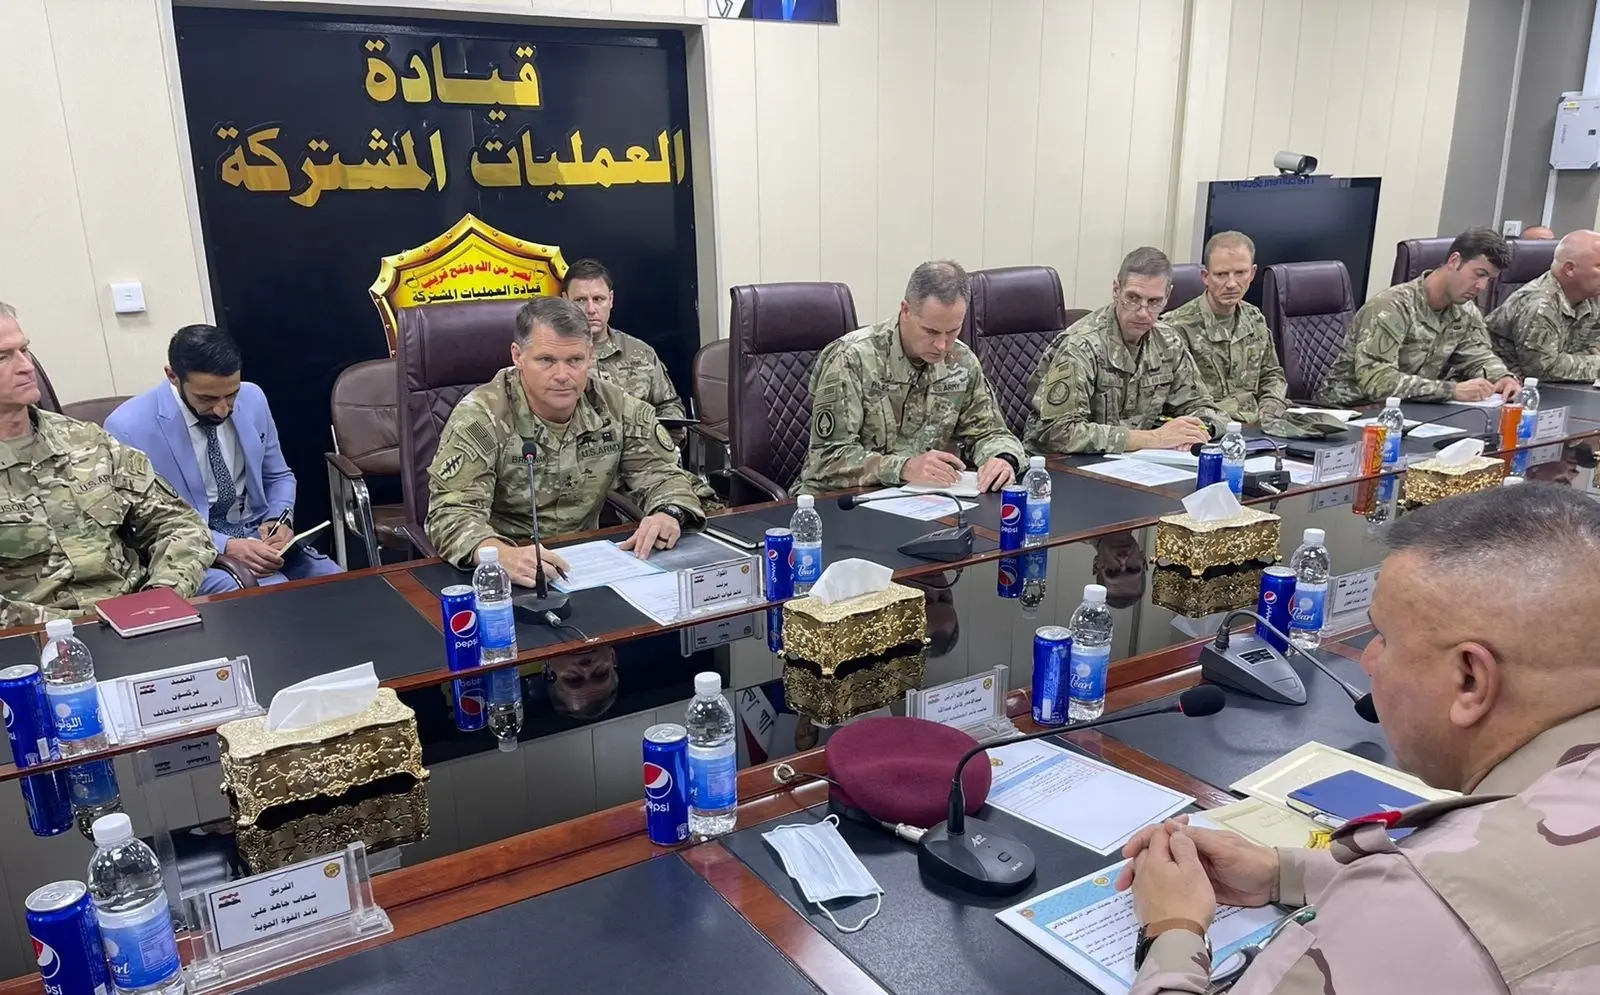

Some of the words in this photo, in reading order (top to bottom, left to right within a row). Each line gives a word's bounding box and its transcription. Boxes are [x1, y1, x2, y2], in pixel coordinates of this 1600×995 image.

[365, 38, 540, 120] قيادة
[216, 126, 446, 208] المشتركة
[470, 128, 685, 201] العمليات
[449, 262, 474, 278] وفتح
[475, 260, 491, 272] الله
[493, 265, 509, 275] من
[421, 268, 449, 289] قريب
[510, 270, 532, 282] نصر
[412, 289, 458, 303] المشتركة
[460, 285, 511, 299] العمليات
[513, 282, 541, 296] قيادة
[455, 637, 478, 649] pepsi
[1070, 673, 1094, 690] Pearl
[269, 881, 295, 896] الفريق
[250, 906, 267, 919] علي
[112, 962, 130, 976] arl
[45, 984, 63, 995] psi
